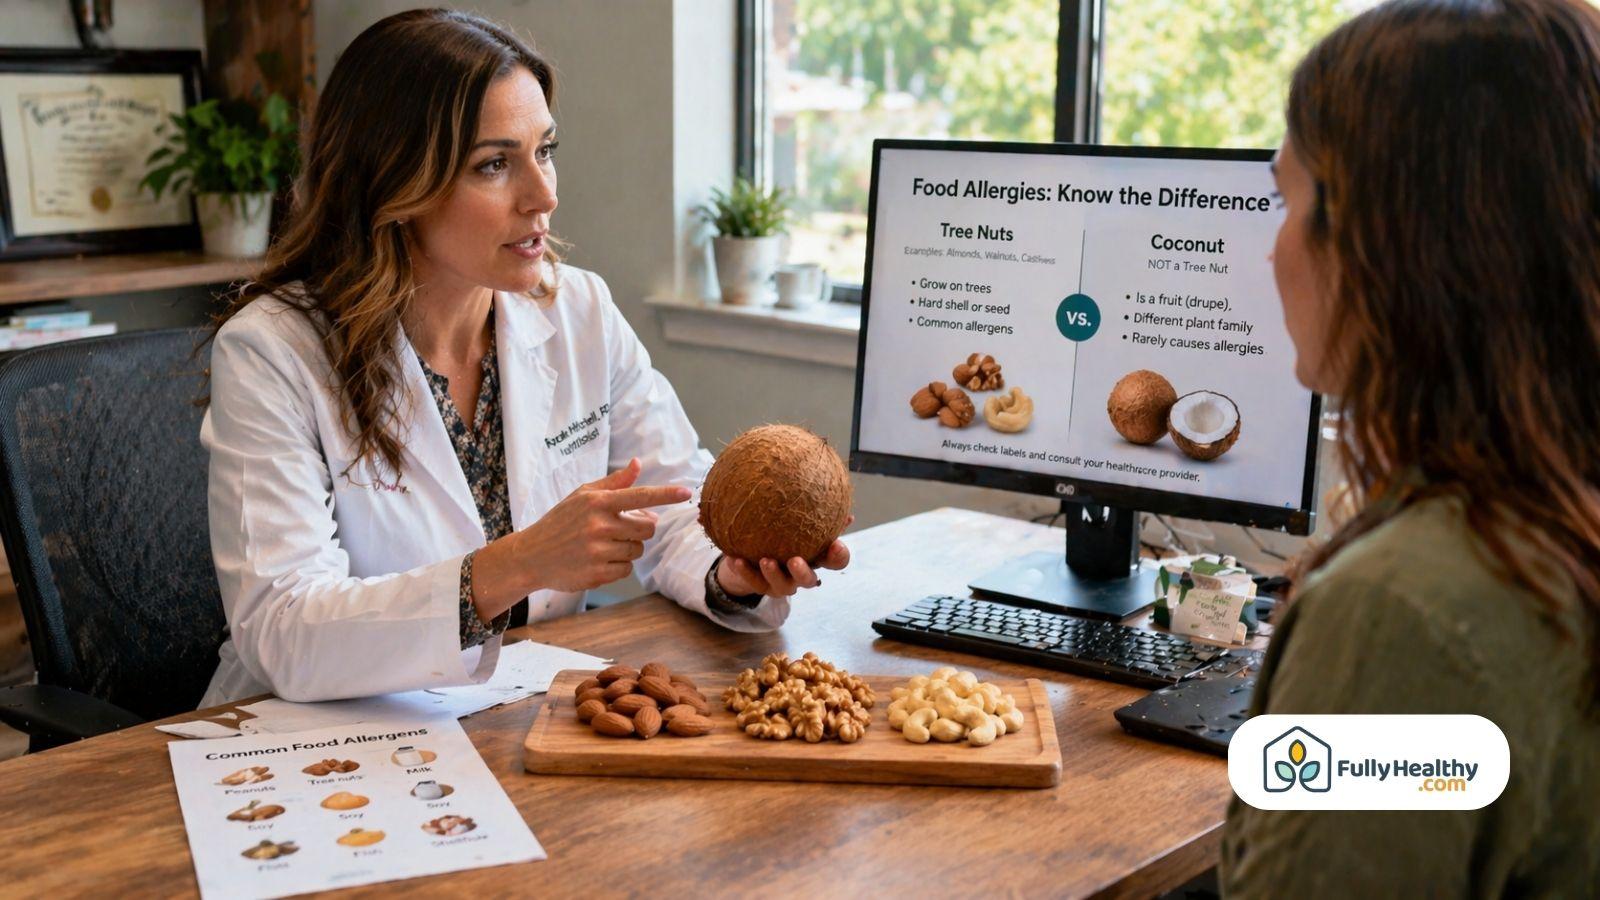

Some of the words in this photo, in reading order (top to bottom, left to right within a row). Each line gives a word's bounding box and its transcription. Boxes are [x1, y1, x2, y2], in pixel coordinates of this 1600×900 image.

[912, 177, 959, 198] Food
[963, 179, 1051, 205] Allergies:
[1057, 183, 1113, 204] Know
[1119, 186, 1152, 206] the
[1158, 187, 1271, 212] Difference
[940, 222, 973, 239] Tree
[977, 224, 1014, 242] Nuts
[1150, 233, 1225, 254] Coconut
[1147, 258, 1172, 271] NOT
[1173, 262, 1180, 271] a
[1183, 261, 1206, 273] Tree
[1209, 262, 1228, 274] Nut
[919, 277, 947, 291] Grow
[949, 281, 963, 292] on
[965, 282, 992, 294] trees
[918, 297, 943, 309] Hard
[945, 298, 969, 311] shell
[971, 303, 982, 313] or
[984, 304, 1011, 316] seed
[1136, 292, 1146, 304] Is
[1148, 295, 1155, 305] a
[1158, 293, 1183, 307] fruit
[917, 316, 963, 330] Common
[965, 319, 1014, 336] allergens
[1066, 310, 1092, 327] VS.
[1133, 312, 1184, 327] Different
[1185, 316, 1216, 331] plant
[1218, 318, 1254, 336] family
[1132, 332, 1168, 349] Rarely
[1169, 337, 1211, 350] causes
[1213, 340, 1264, 356] allergies
[942, 439, 972, 453] Always
[973, 443, 999, 454] check
[1000, 446, 1027, 458] labels
[1029, 451, 1047, 461] and
[1048, 453, 1081, 466] consult
[1083, 458, 1104, 469] your
[1159, 468, 1201, 483] provider.
[205, 746, 288, 761] Common
[292, 738, 339, 751] Food
[344, 728, 428, 746] Allergens
[406, 766, 432, 775] Milk
